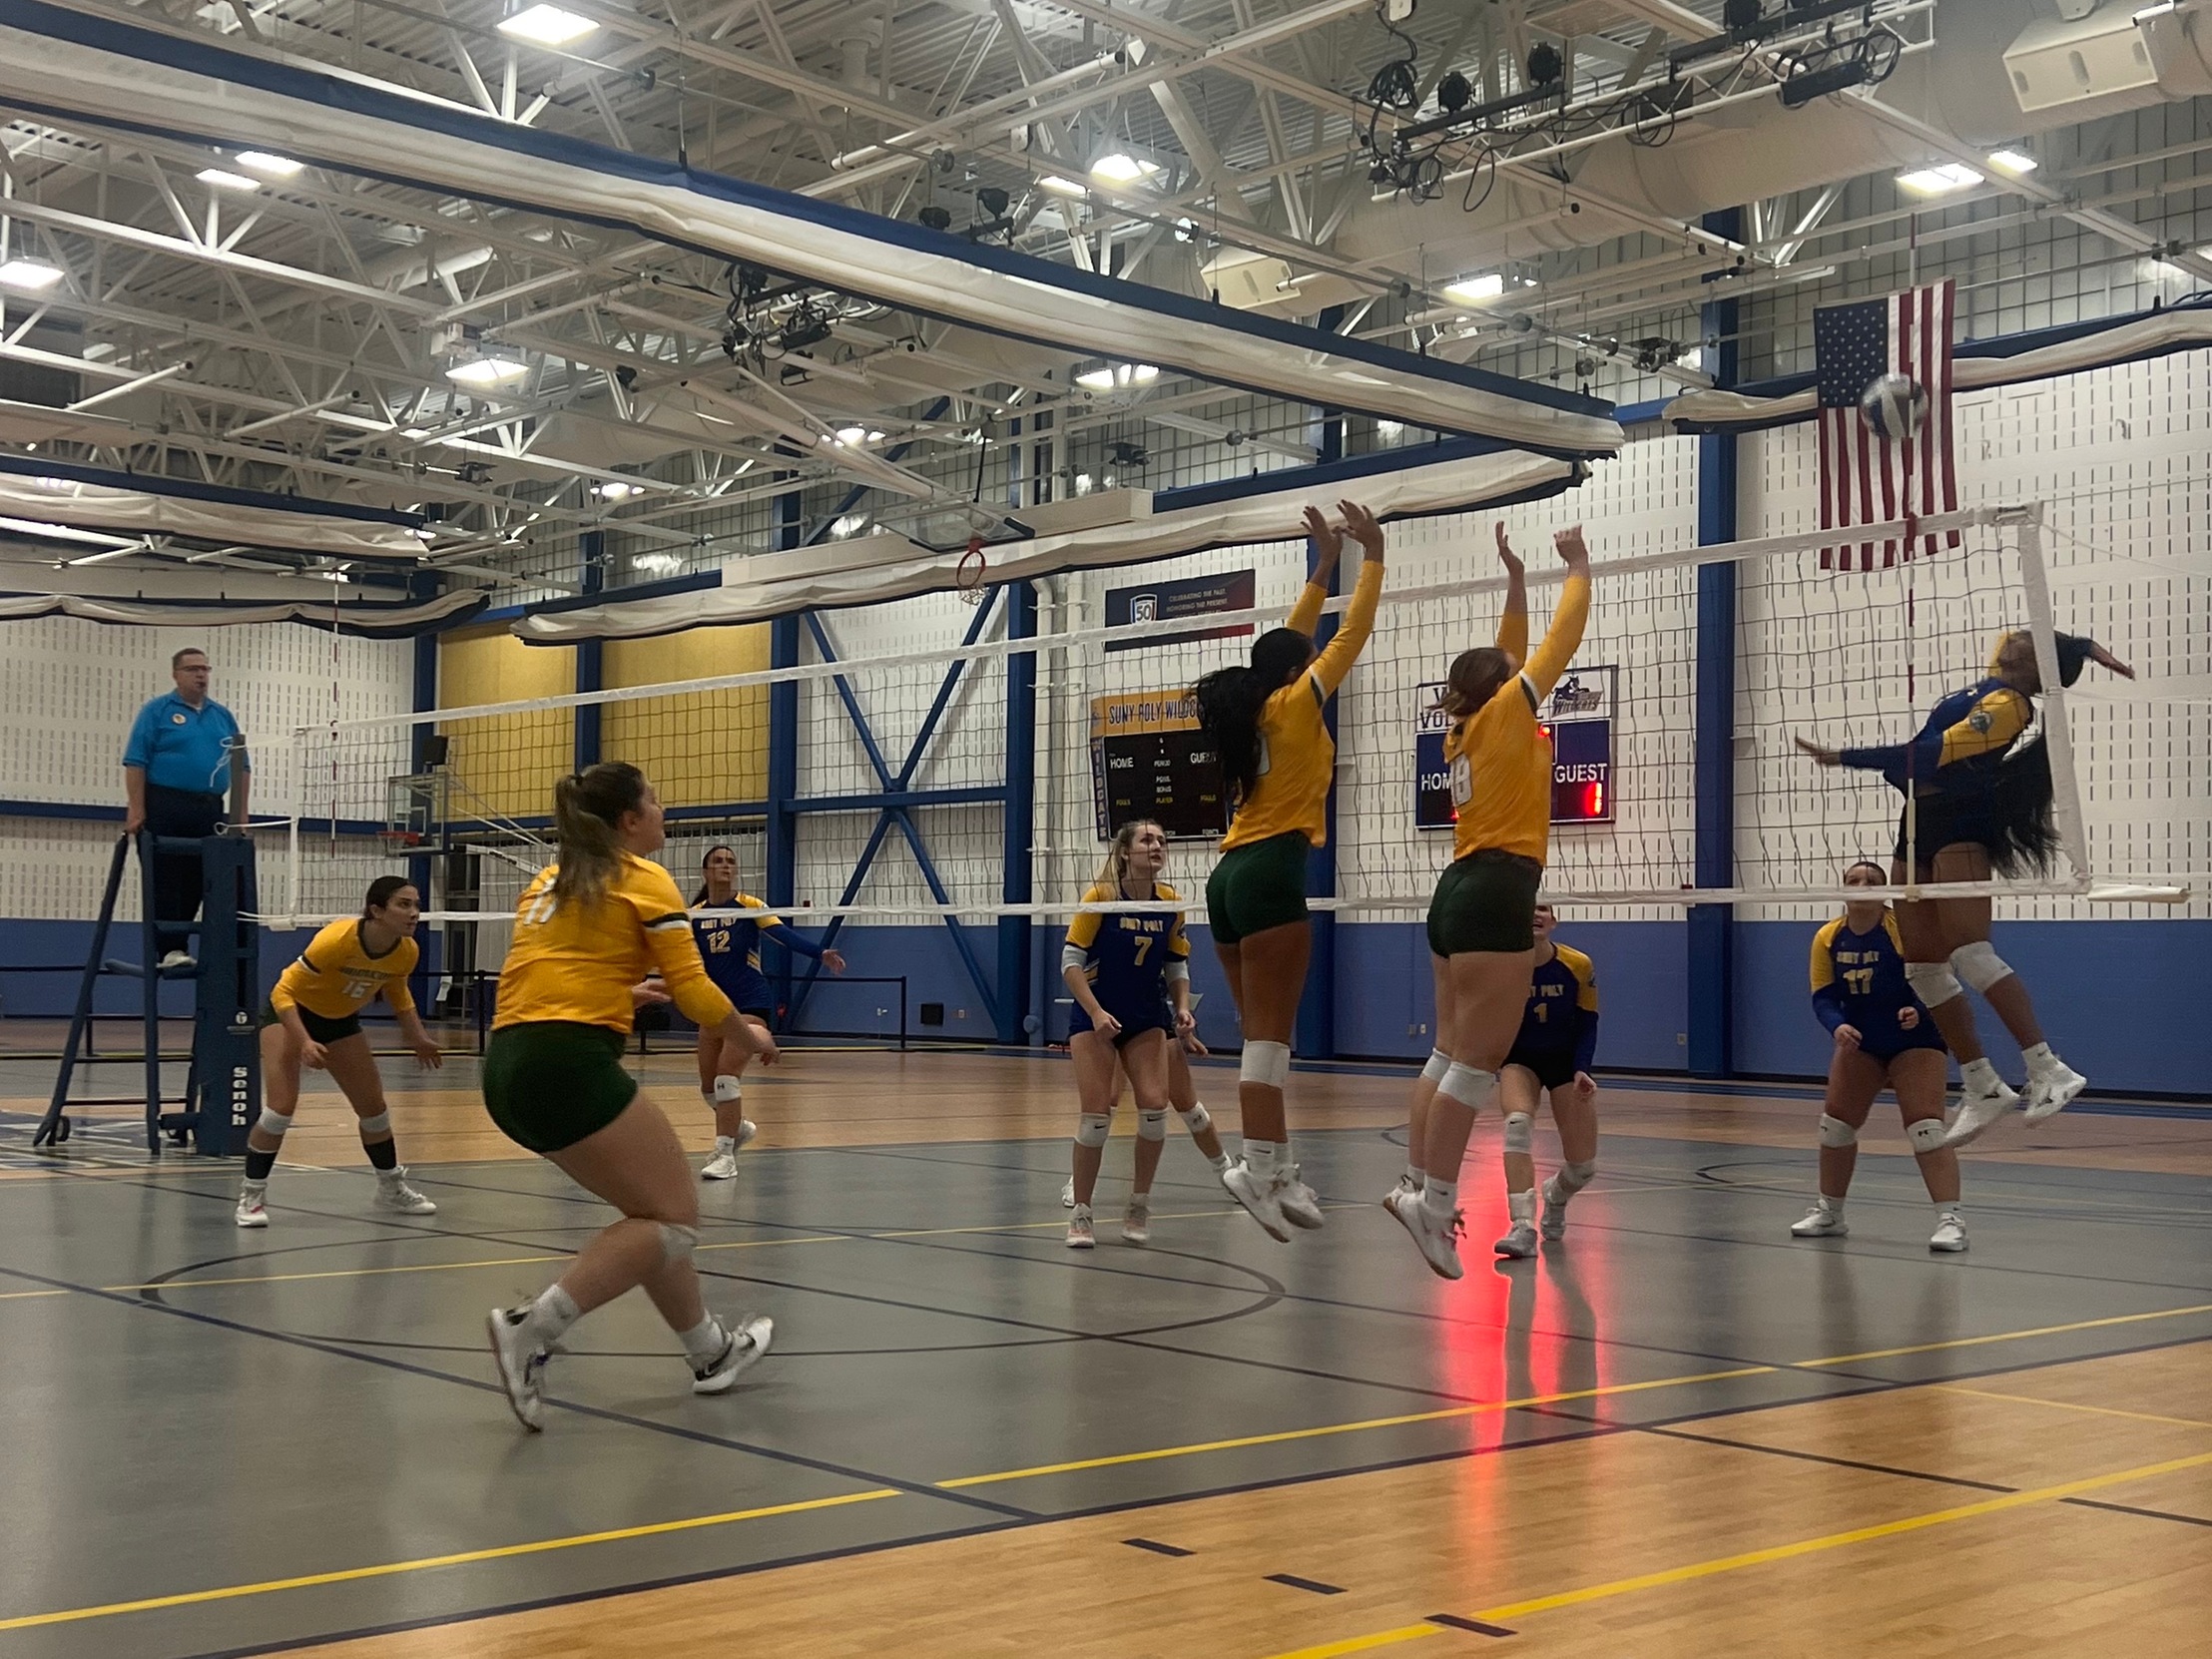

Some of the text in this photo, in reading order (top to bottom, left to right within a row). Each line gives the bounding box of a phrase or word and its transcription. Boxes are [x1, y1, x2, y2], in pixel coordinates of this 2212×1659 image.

[1136, 603, 1151, 621] 50
[1109, 699, 1198, 725] SUNY POLY WILDC
[1110, 757, 1134, 770] HOME
[1554, 763, 1608, 784] GUEST
[1421, 772, 1451, 791] HOM
[707, 929, 731, 953] 12
[1134, 935, 1153, 965] 7
[1843, 967, 1874, 994] 17
[232, 1066, 248, 1126] Senoh
